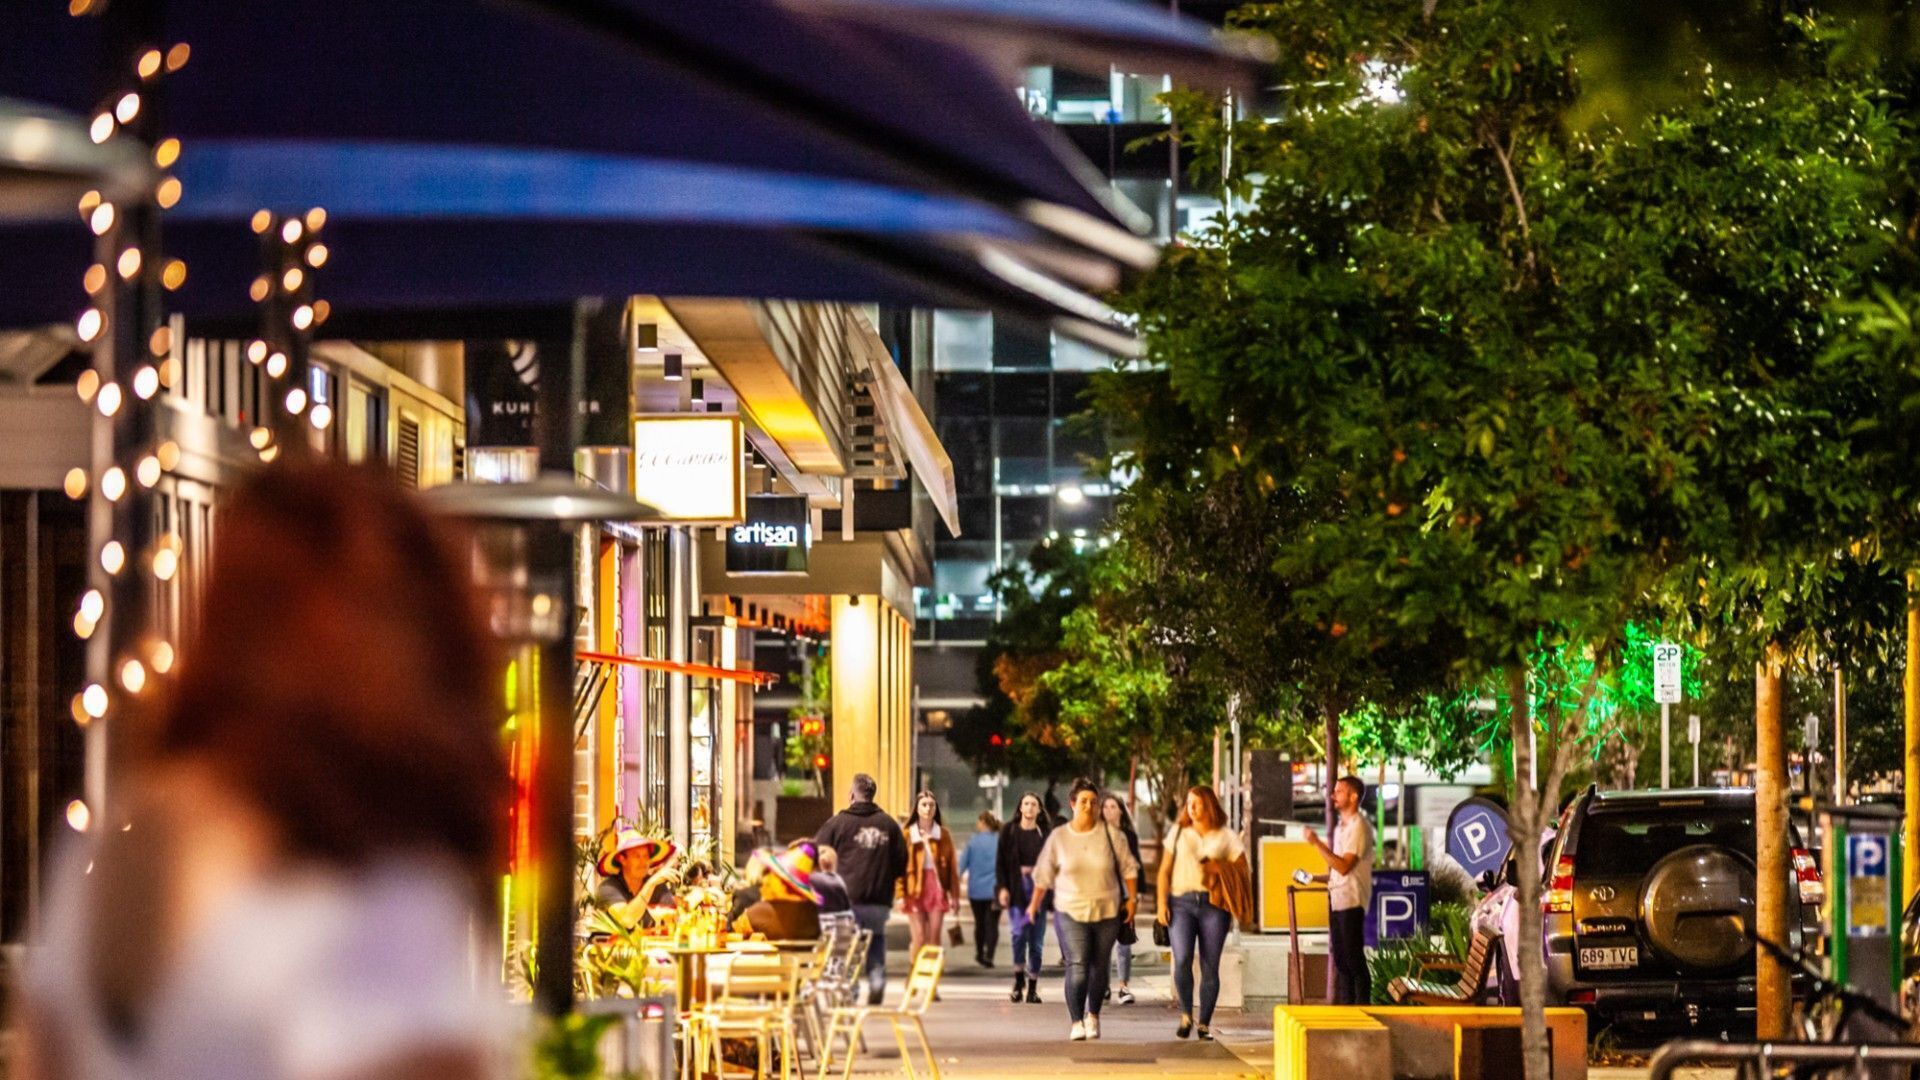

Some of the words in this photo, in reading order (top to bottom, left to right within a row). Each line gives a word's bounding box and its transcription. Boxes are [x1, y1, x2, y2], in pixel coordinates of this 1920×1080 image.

[734, 522, 797, 544] artisan
[1657, 647, 1678, 661] 2P
[1463, 821, 1487, 857] P
[1856, 840, 1882, 877] P
[1381, 895, 1413, 938] P
